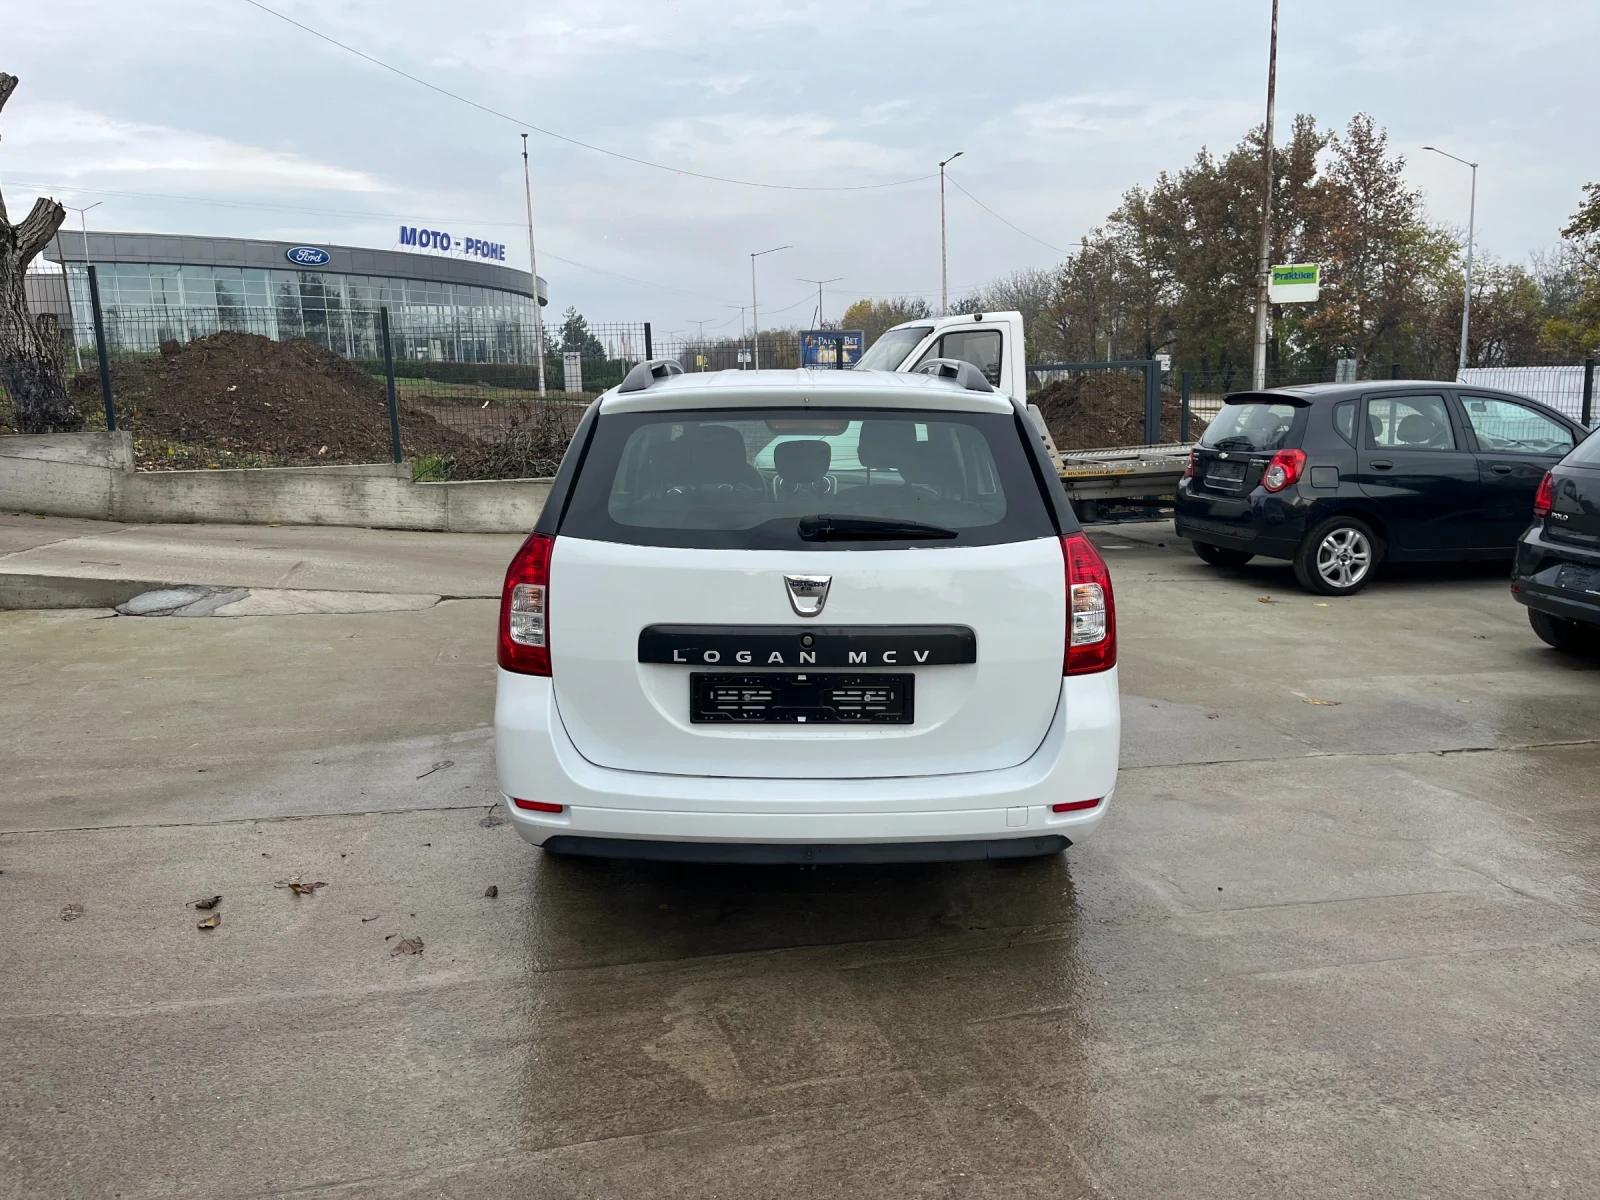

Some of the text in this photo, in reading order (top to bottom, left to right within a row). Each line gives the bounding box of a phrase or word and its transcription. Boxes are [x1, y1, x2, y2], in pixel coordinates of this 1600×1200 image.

[400, 226, 451, 251] MOTO
[466, 237, 506, 261] PFOHE
[1274, 271, 1314, 280] Praktiker
[1551, 512, 1569, 521] POLO
[673, 650, 929, 664] LOGAN MCV
